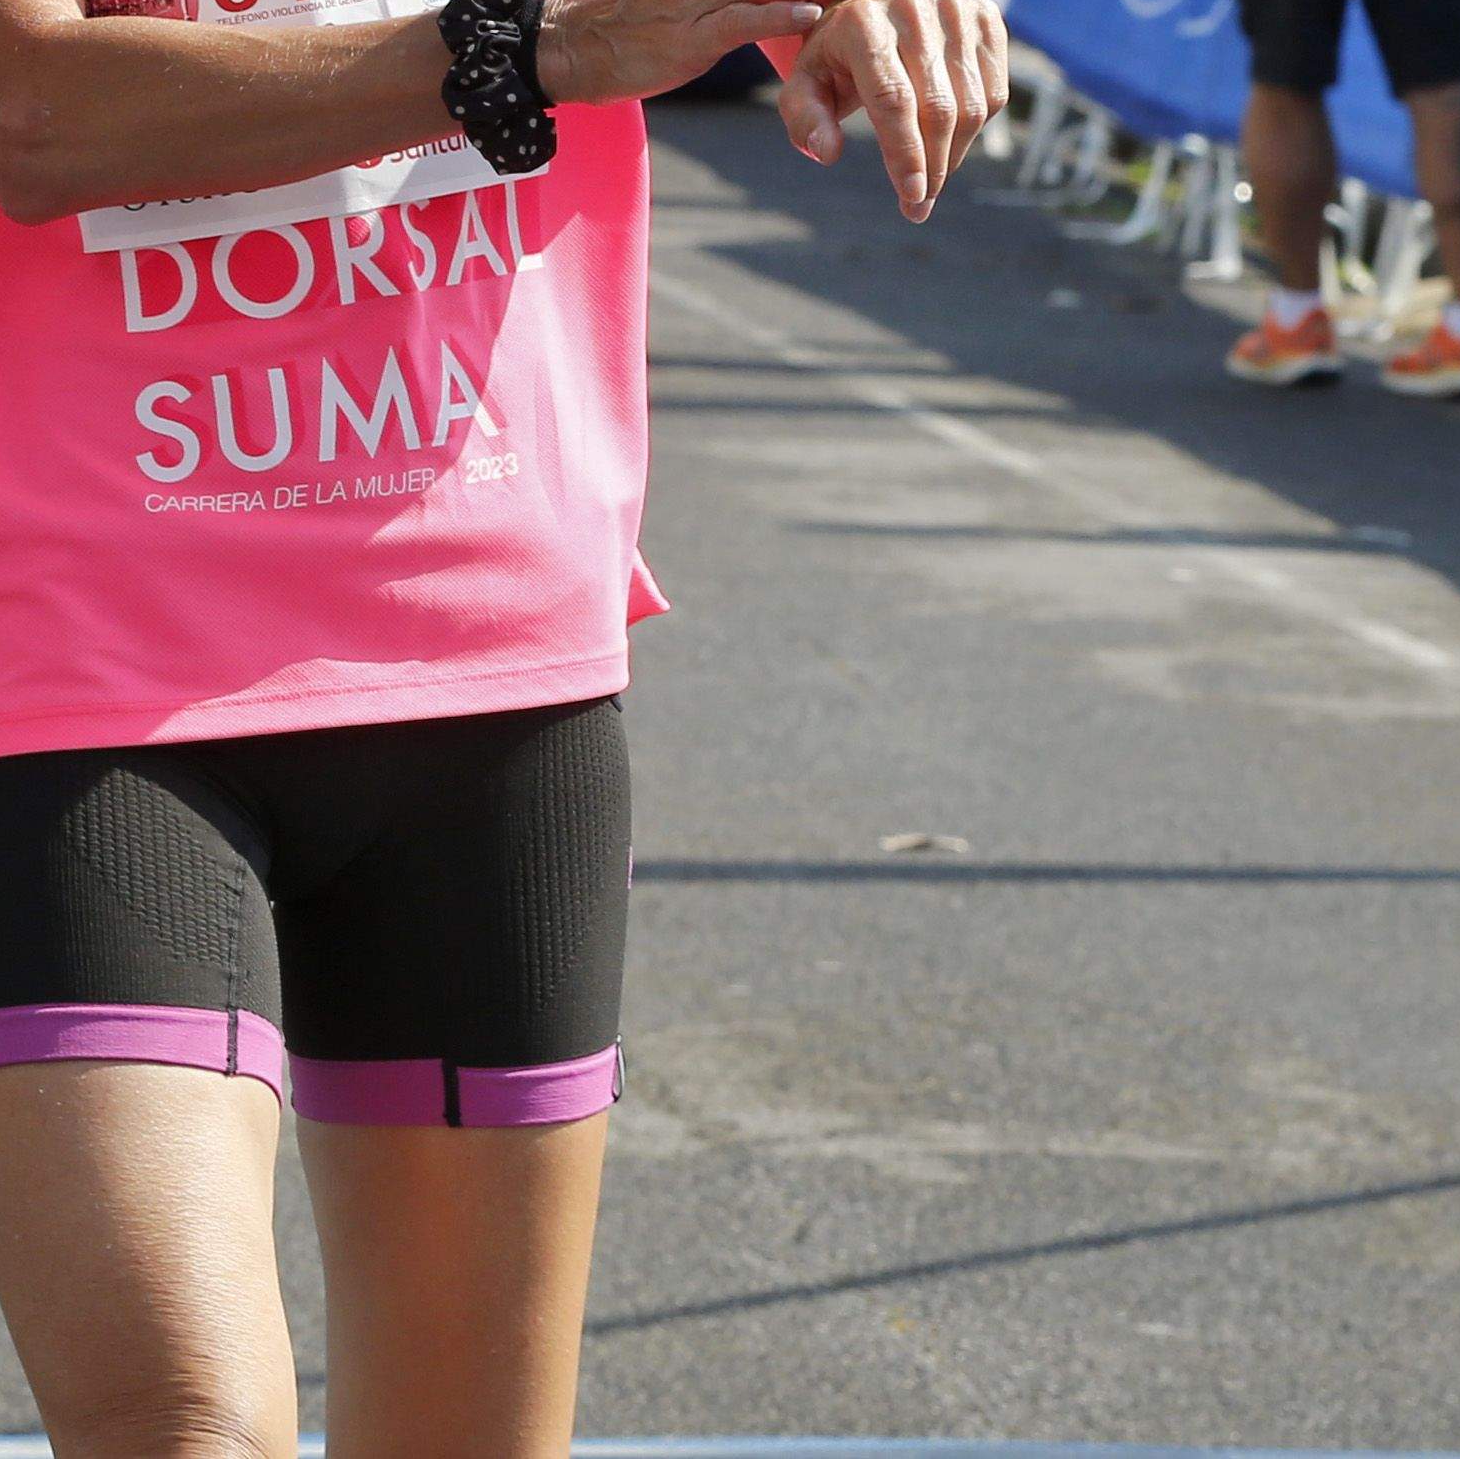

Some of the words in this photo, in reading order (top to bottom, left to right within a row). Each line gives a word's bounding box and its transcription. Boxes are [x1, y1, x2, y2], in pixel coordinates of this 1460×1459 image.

[271, 2, 324, 19] VIOLENCIA
[325, 0, 337, 9] DE
[119, 181, 544, 333] DORSAL
[135, 339, 501, 483] SUMA
[144, 491, 266, 513] CARRERA
[273, 484, 310, 510] DE
[315, 479, 348, 504] LA
[353, 468, 437, 500] MUJER
[465, 452, 520, 485] 2023
